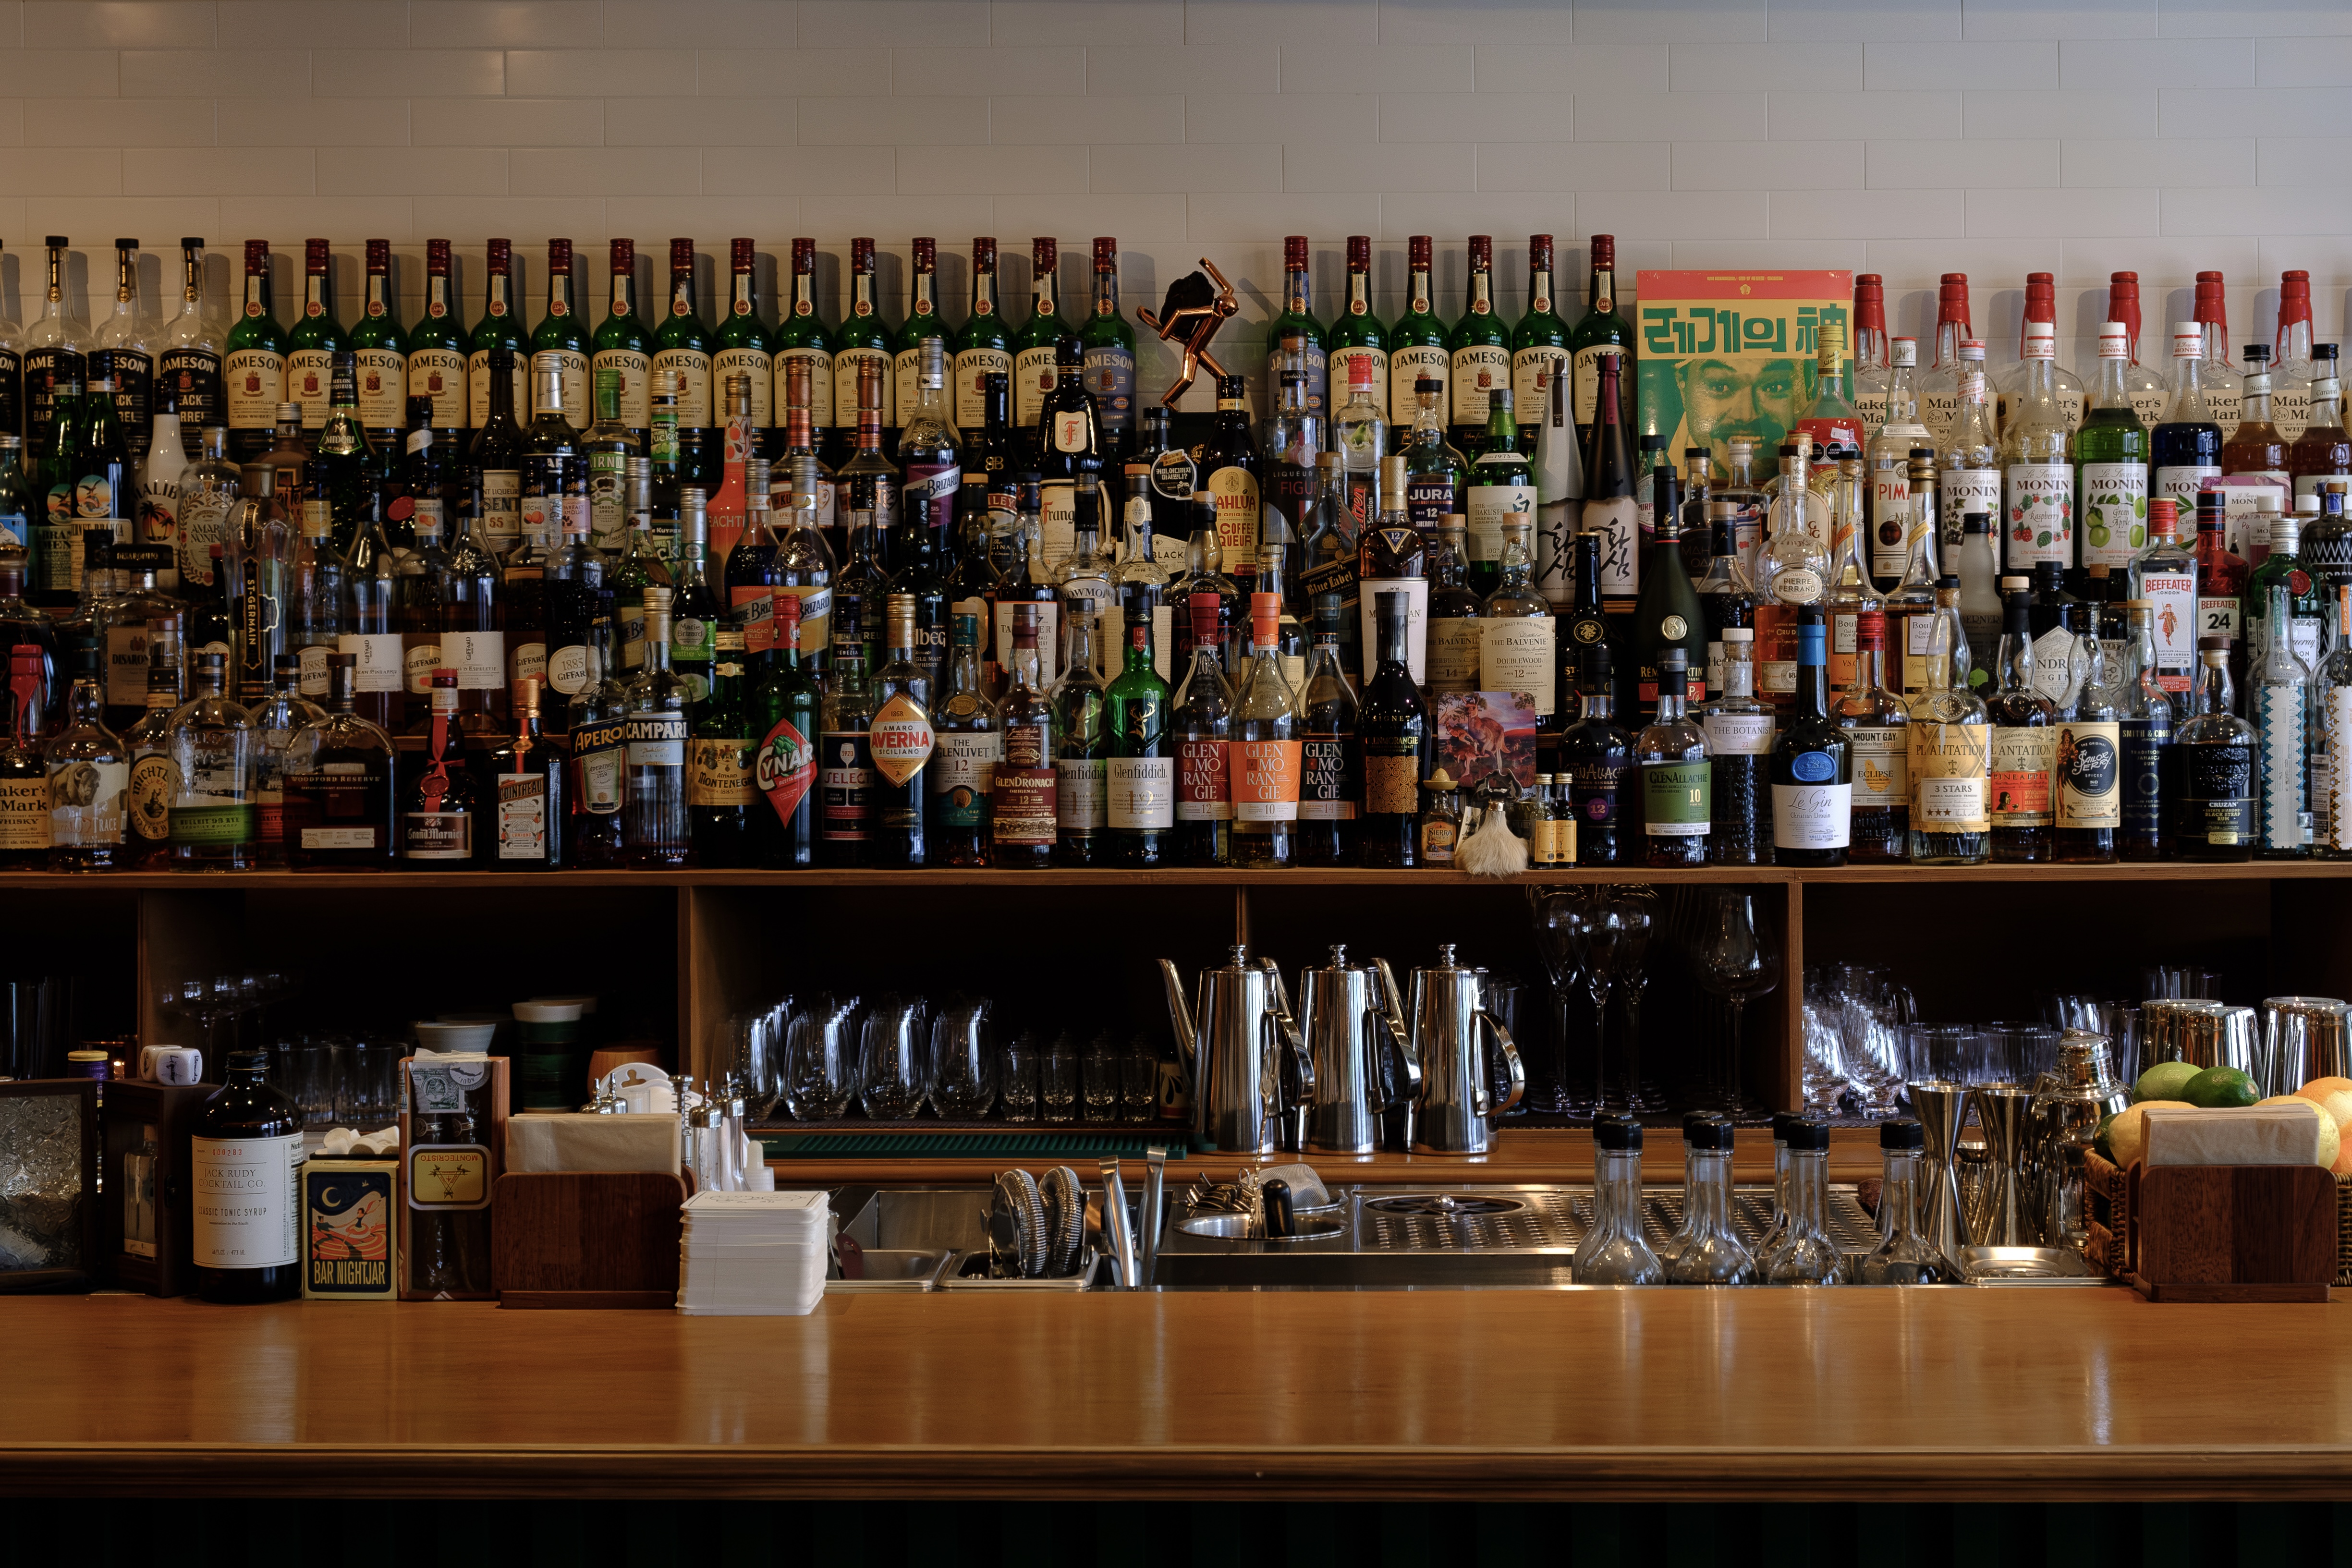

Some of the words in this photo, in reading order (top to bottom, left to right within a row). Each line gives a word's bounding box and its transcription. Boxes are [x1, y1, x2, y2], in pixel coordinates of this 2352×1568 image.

[161, 353, 219, 374] JAMESON
[227, 355, 282, 374] JAMESON
[409, 355, 465, 373] JAMESON
[594, 355, 648, 372] JAMESON
[653, 354, 709, 373] JAMESON
[715, 354, 771, 373] JAMESON
[956, 353, 1011, 370] JAMESON
[1394, 352, 1449, 370] JAMESON
[1455, 352, 1511, 370] JAMESON
[2316, 389, 2338, 397] Caramel
[325, 436, 354, 444] MIDORI
[928, 474, 959, 494] BRIZARD
[2016, 479, 2070, 490] MONIN
[2091, 479, 2145, 489] MONIN
[1409, 489, 1453, 501] JURA
[1946, 486, 1998, 497] MONIN
[1426, 508, 1438, 517] 12
[2028, 511, 2060, 523] Raspberry
[2113, 508, 2130, 517] Green
[489, 517, 503, 527] 55
[2112, 516, 2131, 529] Apple
[1220, 523, 1255, 535] COFFEE
[1390, 532, 1400, 540] 12
[1306, 577, 1329, 596] Blue
[1328, 571, 1353, 589] Label
[1783, 577, 1811, 585] PIERRE
[2145, 579, 2192, 594] BEEFEATER
[2201, 600, 2238, 610] BEEFEATER
[246, 578, 256, 646] ST-GERMAIN
[679, 622, 700, 631] Marie
[2207, 613, 2231, 629] 24
[677, 630, 703, 638] Brizard
[1199, 635, 1209, 644] 12
[1261, 634, 1270, 644] 10
[1322, 634, 1331, 644] 14
[1506, 636, 1547, 646] BALVENIE
[304, 658, 326, 671] 1885
[408, 657, 440, 669] GIFFARD
[561, 659, 584, 671] 1885
[1446, 669, 1458, 677] 14
[1514, 669, 1524, 678] 12
[625, 721, 687, 740] CAMPARI
[1713, 726, 1729, 735] THE
[1731, 726, 1772, 735] BOTANIST
[1853, 731, 1881, 742] MOUNT
[1882, 731, 1897, 742] GAY
[2122, 730, 2144, 738] SMITH
[574, 726, 625, 752] APERO
[871, 732, 930, 748] AVERNA
[1365, 736, 1419, 746] GLENMORANGIE
[937, 747, 990, 758] GLENLIVET
[1182, 744, 1219, 758] GLEN
[1245, 744, 1283, 758] GLEN
[1305, 744, 1342, 757] GLEN
[756, 741, 814, 791] CYNAR
[954, 759, 968, 771] 12
[1195, 758, 1221, 772] MO
[1258, 758, 1284, 772] MO
[1318, 757, 1344, 771] MO
[823, 771, 874, 785] SELECT
[1183, 772, 1211, 785] RAN
[1246, 772, 1275, 785] RAN
[1306, 772, 1335, 785] RAN
[1649, 771, 1707, 785] GLENALLACHIE
[1858, 769, 1893, 778] ECLIPSE
[995, 776, 1054, 788] GLENDRONACH
[499, 778, 544, 802] COINTREAU
[1194, 786, 1217, 799] GIE
[1258, 786, 1280, 799] GIE
[1317, 785, 1340, 799] GIE
[1934, 784, 1940, 793] 3
[1941, 784, 1972, 793] STARS
[1019, 795, 1029, 804] 12
[1689, 789, 1701, 802] 10
[1791, 790, 1806, 808] Le
[1809, 790, 1833, 810] Gin
[1, 800, 47, 812] Mark
[1201, 803, 1212, 814] 12
[1264, 803, 1275, 814] 10
[1323, 803, 1334, 814] 14
[1590, 804, 1606, 813] 12
[92, 816, 117, 831] TRACE
[407, 827, 427, 839] Grand
[1428, 827, 1452, 837] SIERRA
[212, 1148, 242, 1156] 000283
[204, 1168, 224, 1178] JACK
[227, 1168, 256, 1178] RUDY
[198, 1179, 244, 1188] COCKTAIL
[247, 1179, 266, 1188] CO.
[198, 1206, 219, 1216] CLASSIC
[220, 1207, 242, 1216] TONIC
[244, 1207, 267, 1217] SYRUP
[314, 1261, 334, 1285] BAR
[337, 1261, 386, 1285] NIGHTJAR
